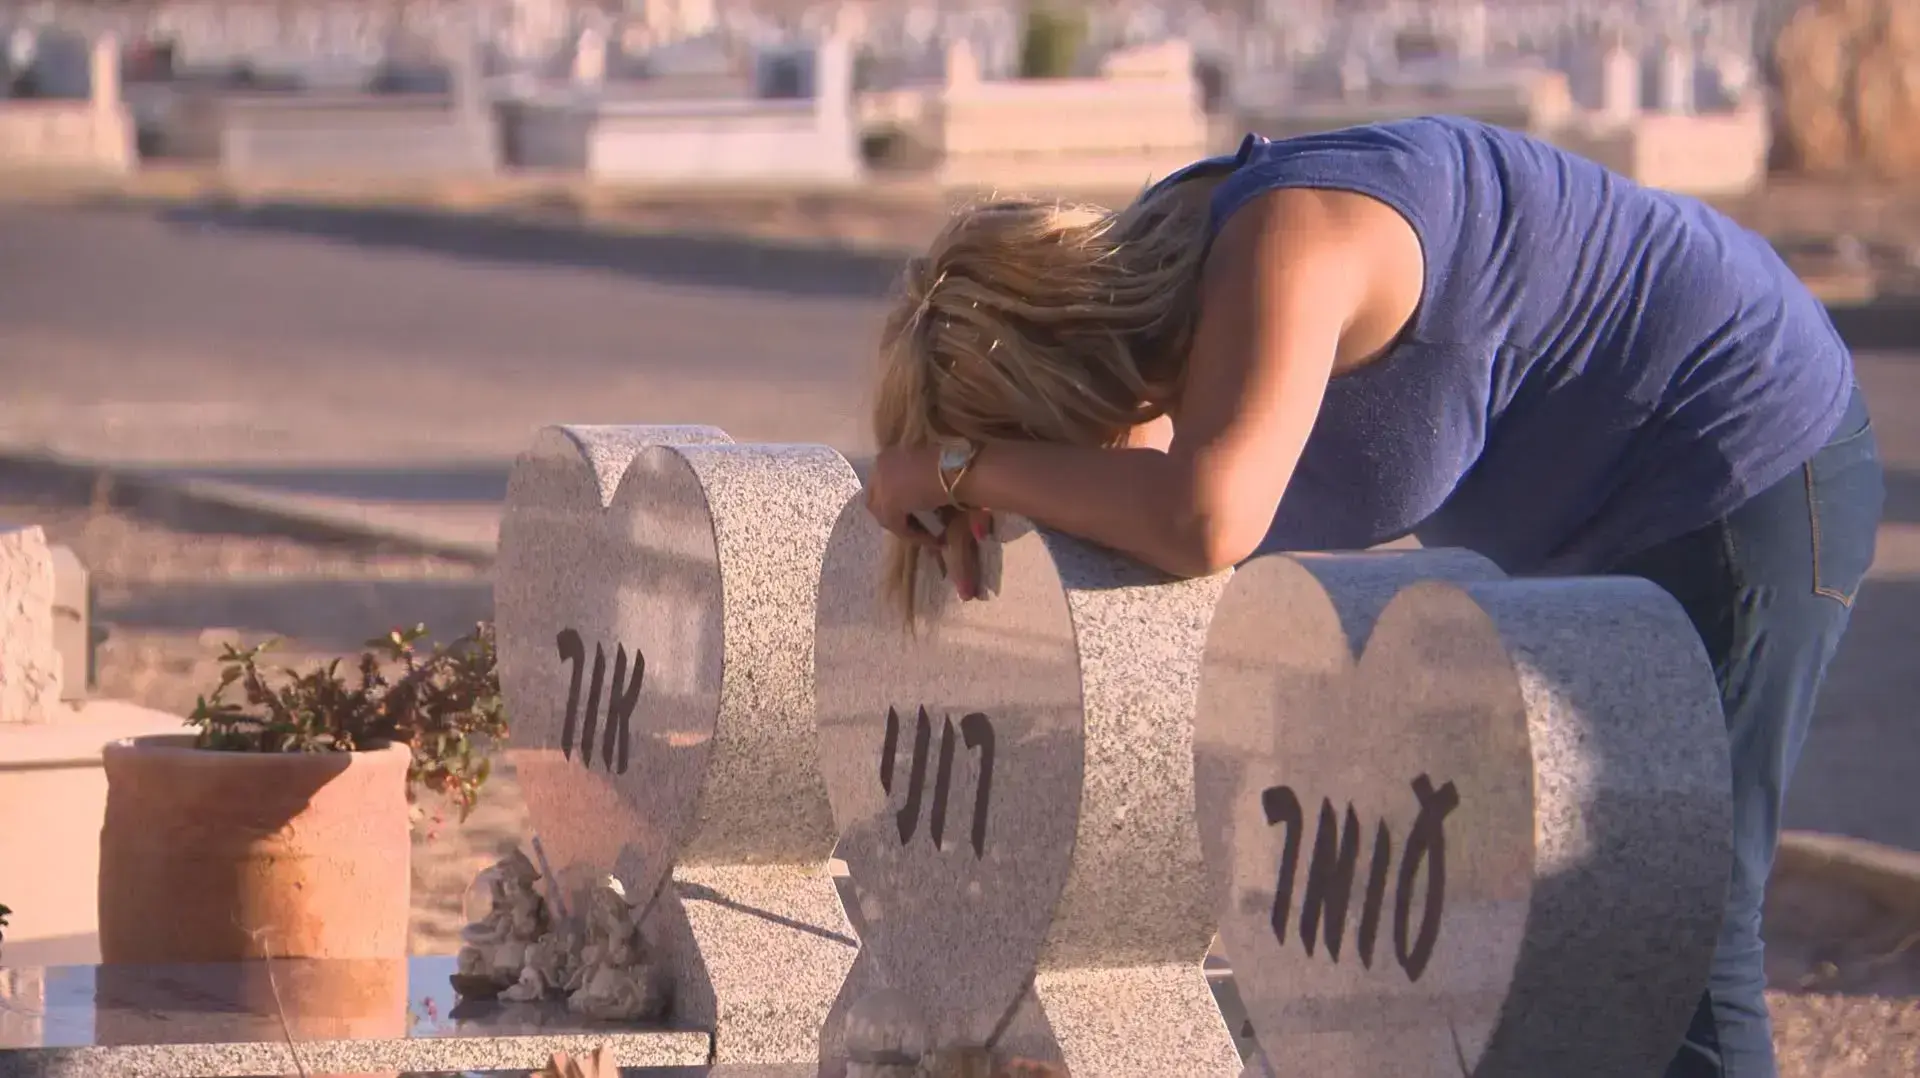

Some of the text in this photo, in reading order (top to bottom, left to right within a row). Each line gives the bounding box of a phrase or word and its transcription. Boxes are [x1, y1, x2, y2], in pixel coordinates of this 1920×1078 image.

[556, 627, 645, 774] אור
[880, 704, 995, 861] רוני
[1261, 772, 1460, 983] עומר
